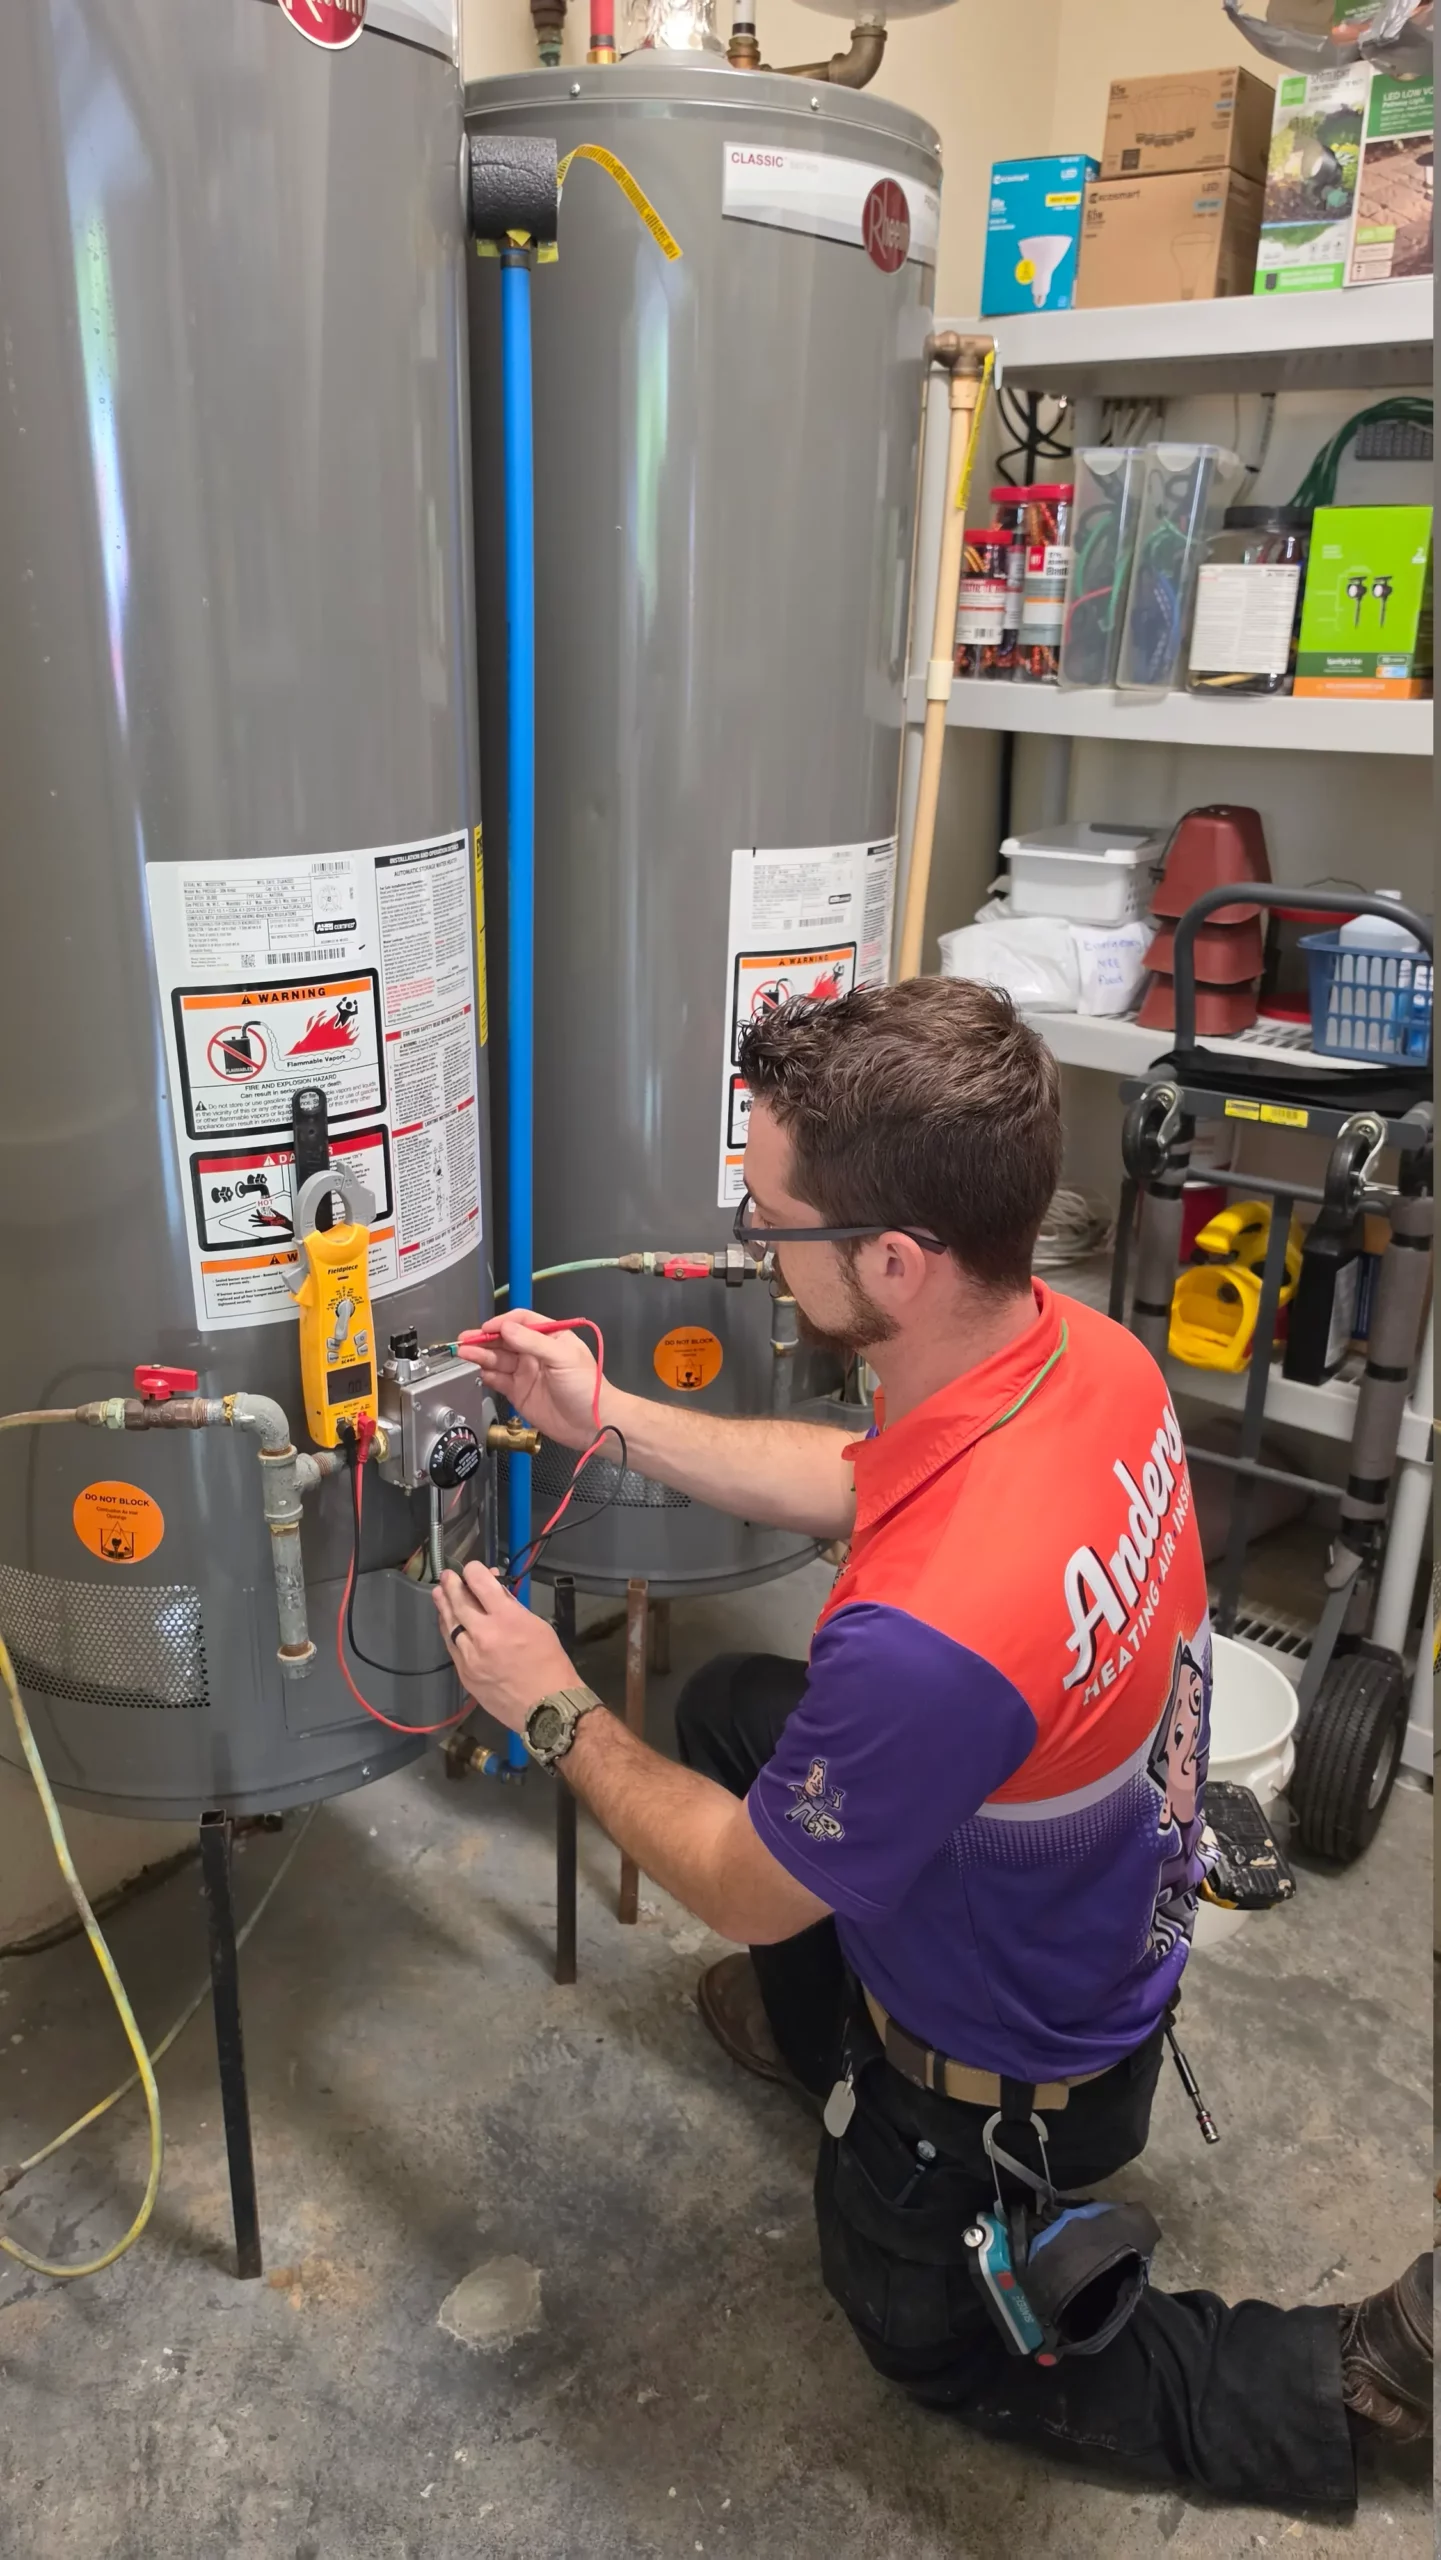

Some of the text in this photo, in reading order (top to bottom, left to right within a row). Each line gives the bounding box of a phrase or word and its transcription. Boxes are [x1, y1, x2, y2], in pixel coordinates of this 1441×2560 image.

[1383, 88, 1422, 101] LED LOW
[731, 151, 784, 168] CLASSIC
[1098, 189, 1141, 201] ecosmart
[868, 181, 908, 260] Rheem
[790, 954, 830, 965] WARNING
[259, 987, 326, 1003] WARNING
[287, 1055, 346, 1067] Flammable Vapors
[277, 1078, 311, 1087] EXPLOSION
[313, 1074, 336, 1082] HAZARD
[264, 1098, 286, 1106] gasoline
[213, 1109, 232, 1117] vicinity
[328, 1264, 358, 1275] Fieldpiece
[85, 1493, 150, 1507] DO NOT BLOCK
[1083, 1579, 1160, 1705] HEATING
[1158, 1531, 1176, 1583] AIR
